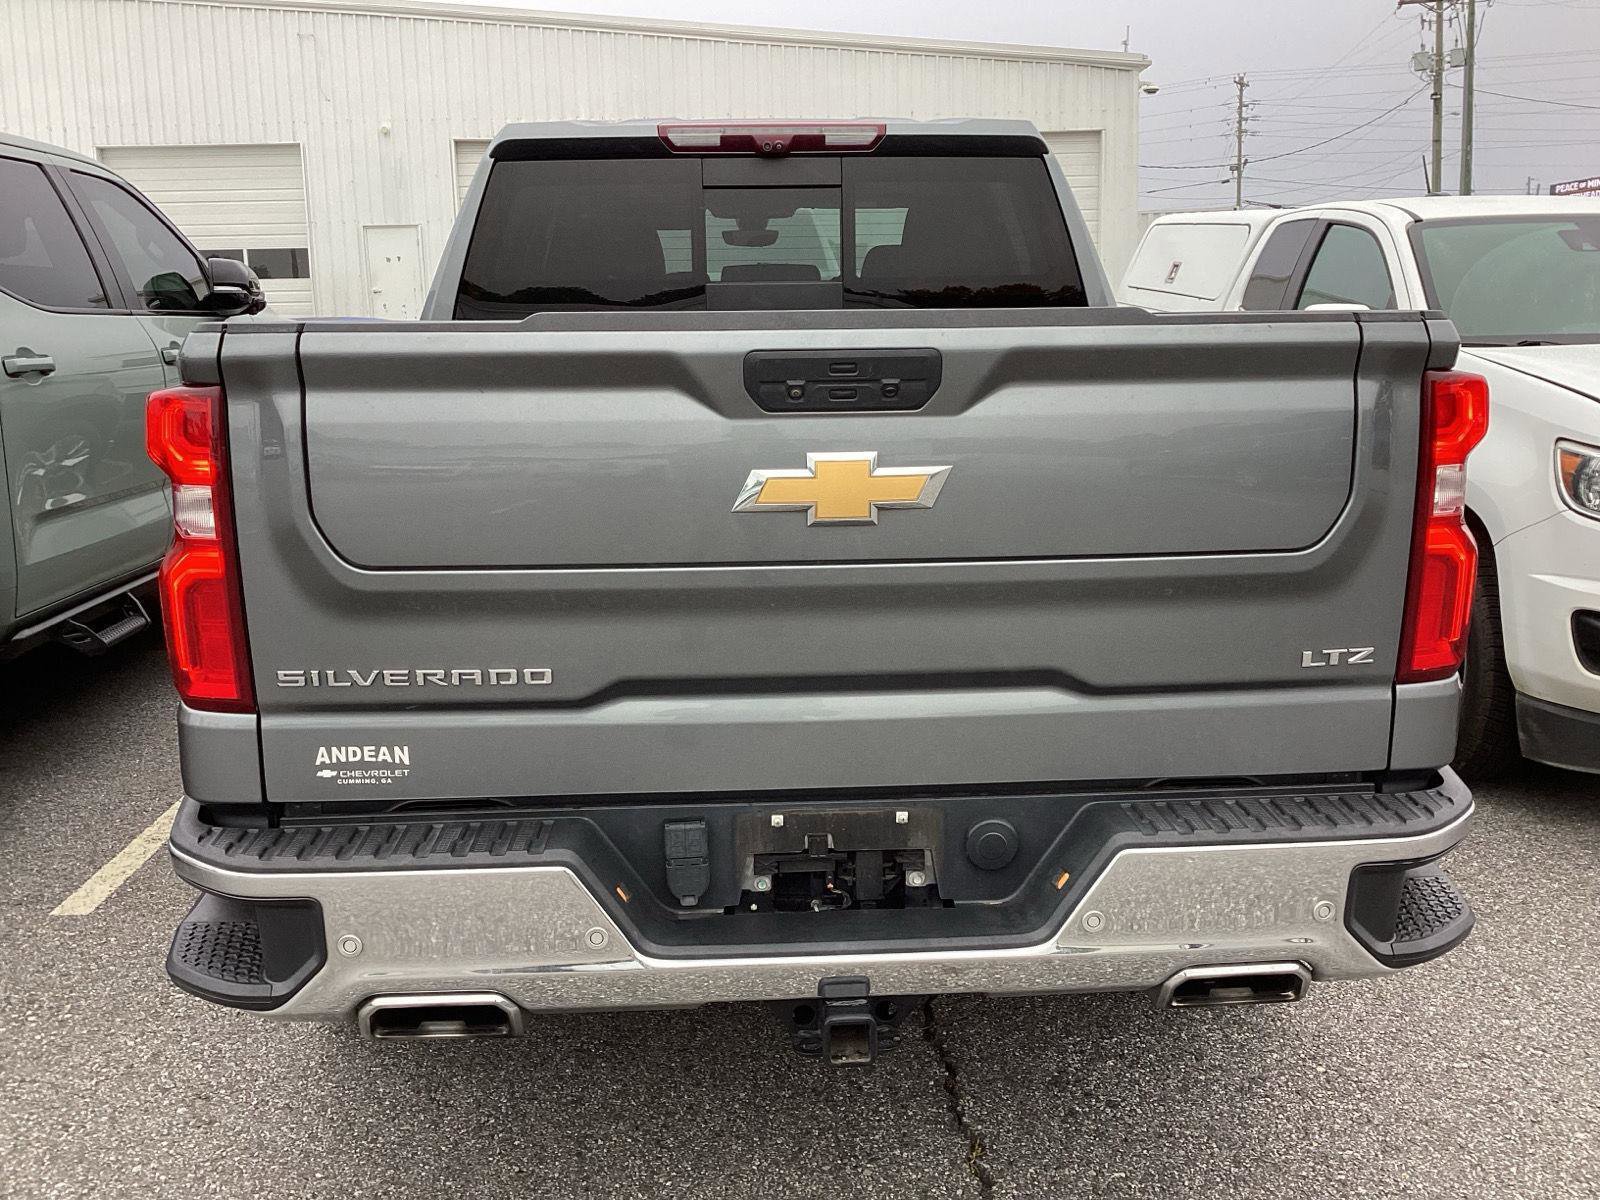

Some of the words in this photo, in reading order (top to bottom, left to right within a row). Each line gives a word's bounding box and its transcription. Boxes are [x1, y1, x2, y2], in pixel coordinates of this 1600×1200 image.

[1555, 182, 1579, 193] PEACE
[1301, 647, 1375, 668] LTZ
[276, 669, 553, 687] SILVERADO
[315, 745, 411, 766] ANDEAN
[339, 769, 411, 778] CHEVROLET
